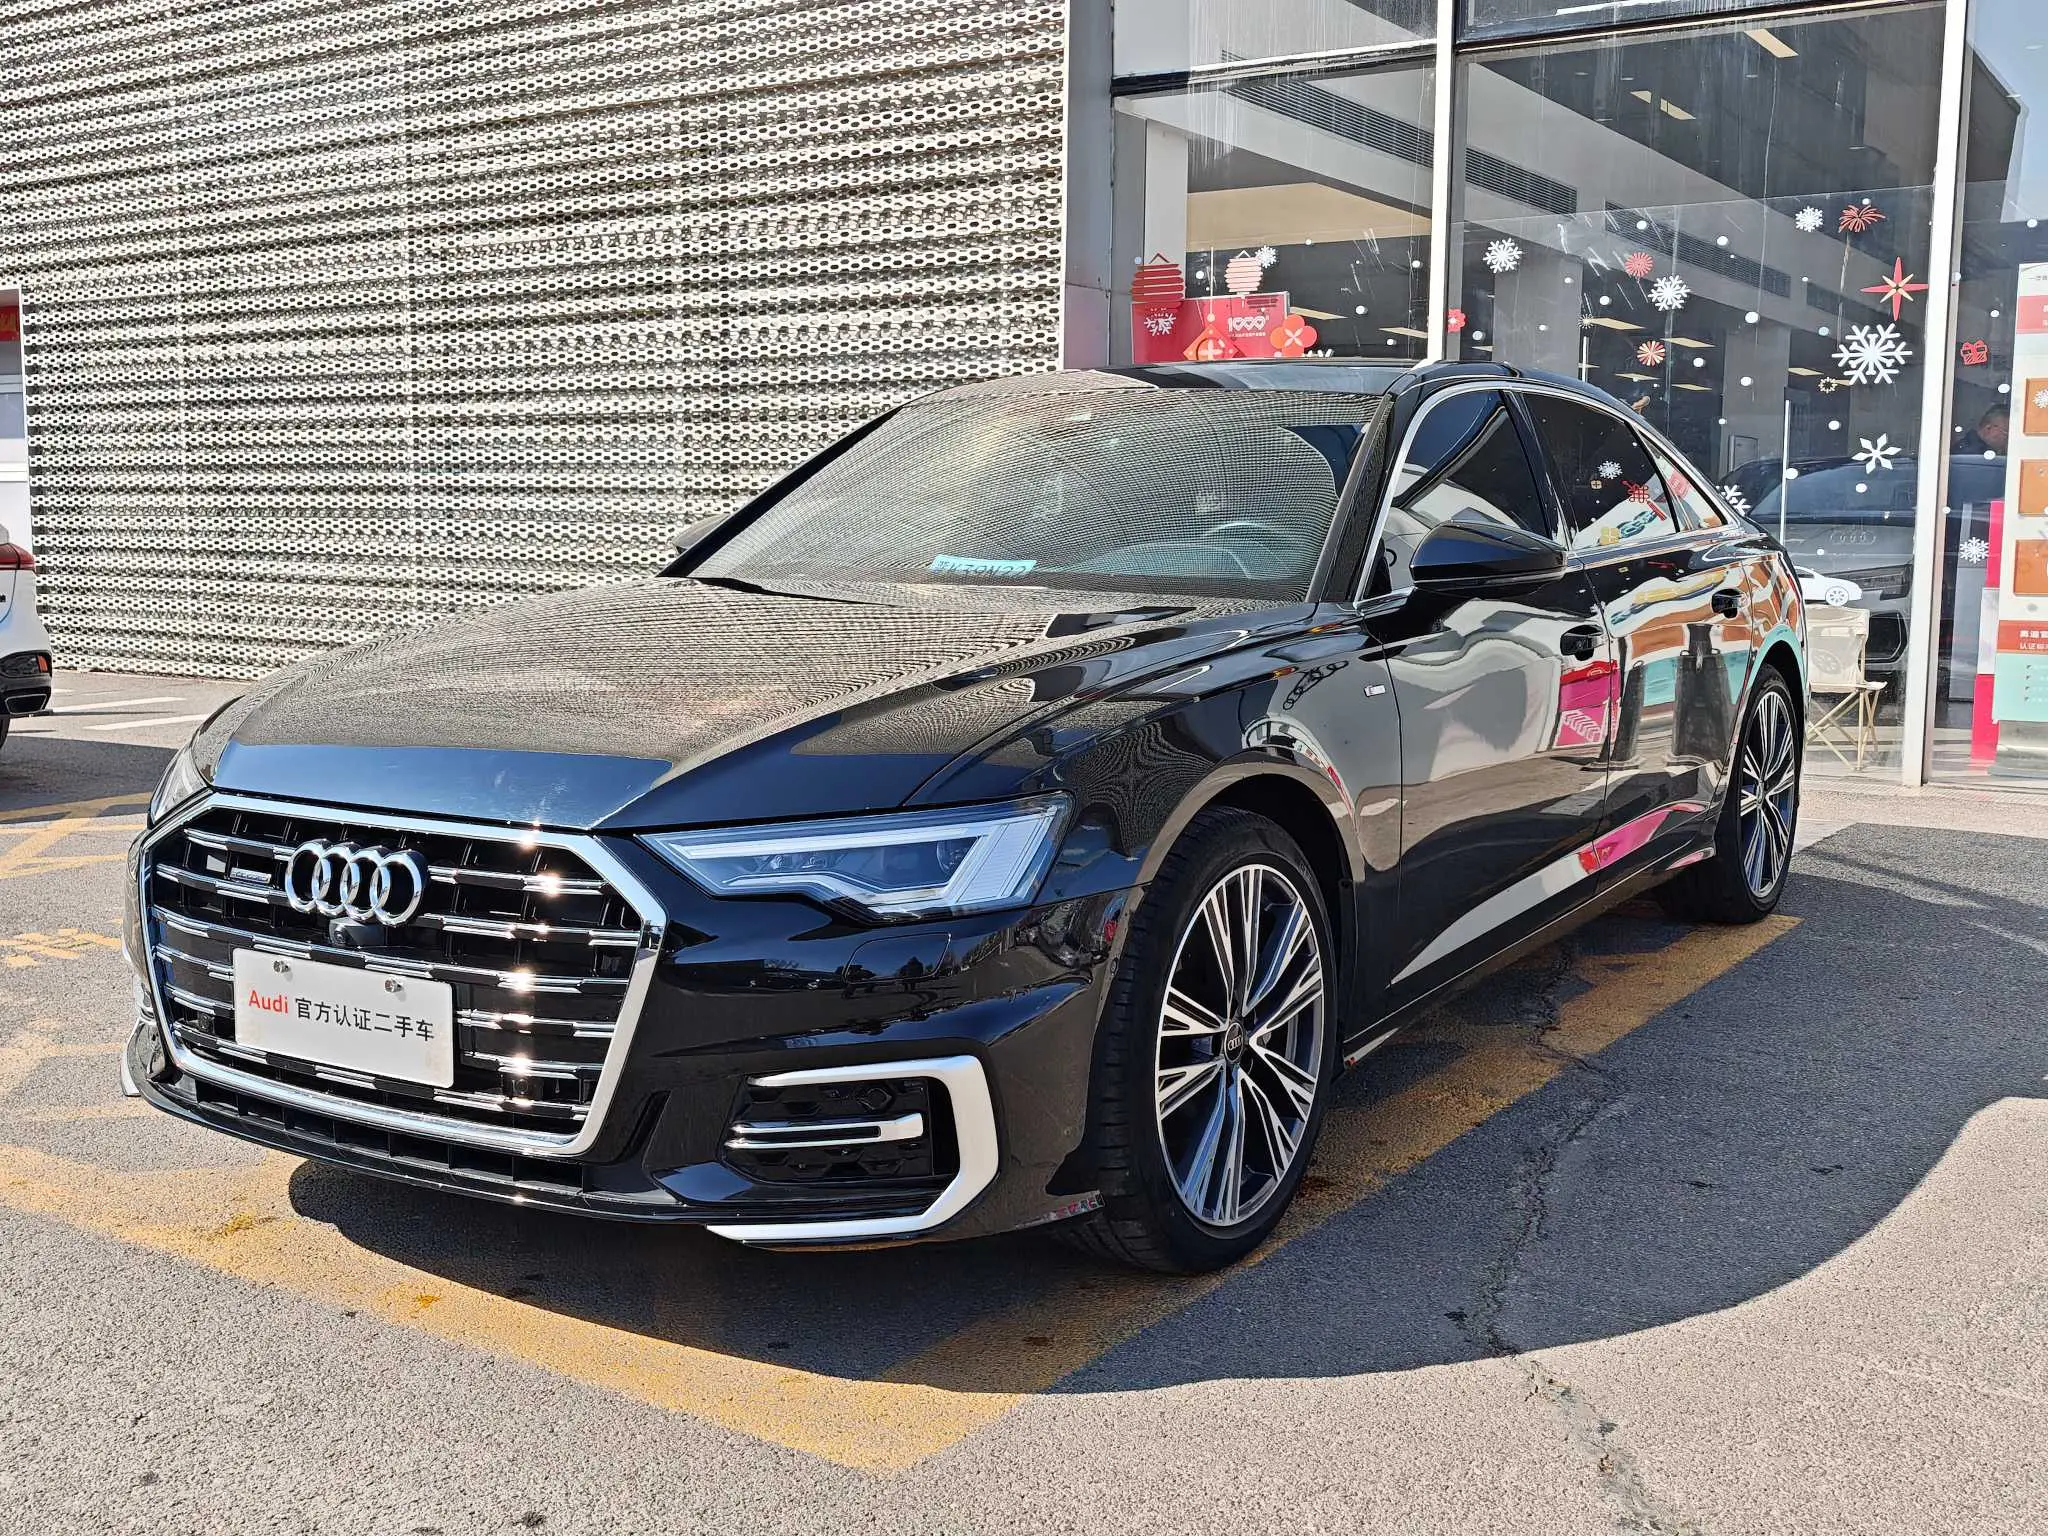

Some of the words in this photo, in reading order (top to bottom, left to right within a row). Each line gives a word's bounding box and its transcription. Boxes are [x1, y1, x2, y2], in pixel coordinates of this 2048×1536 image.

[248, 989, 289, 1014] Audi
[295, 998, 434, 1042] 官方认证二手车
